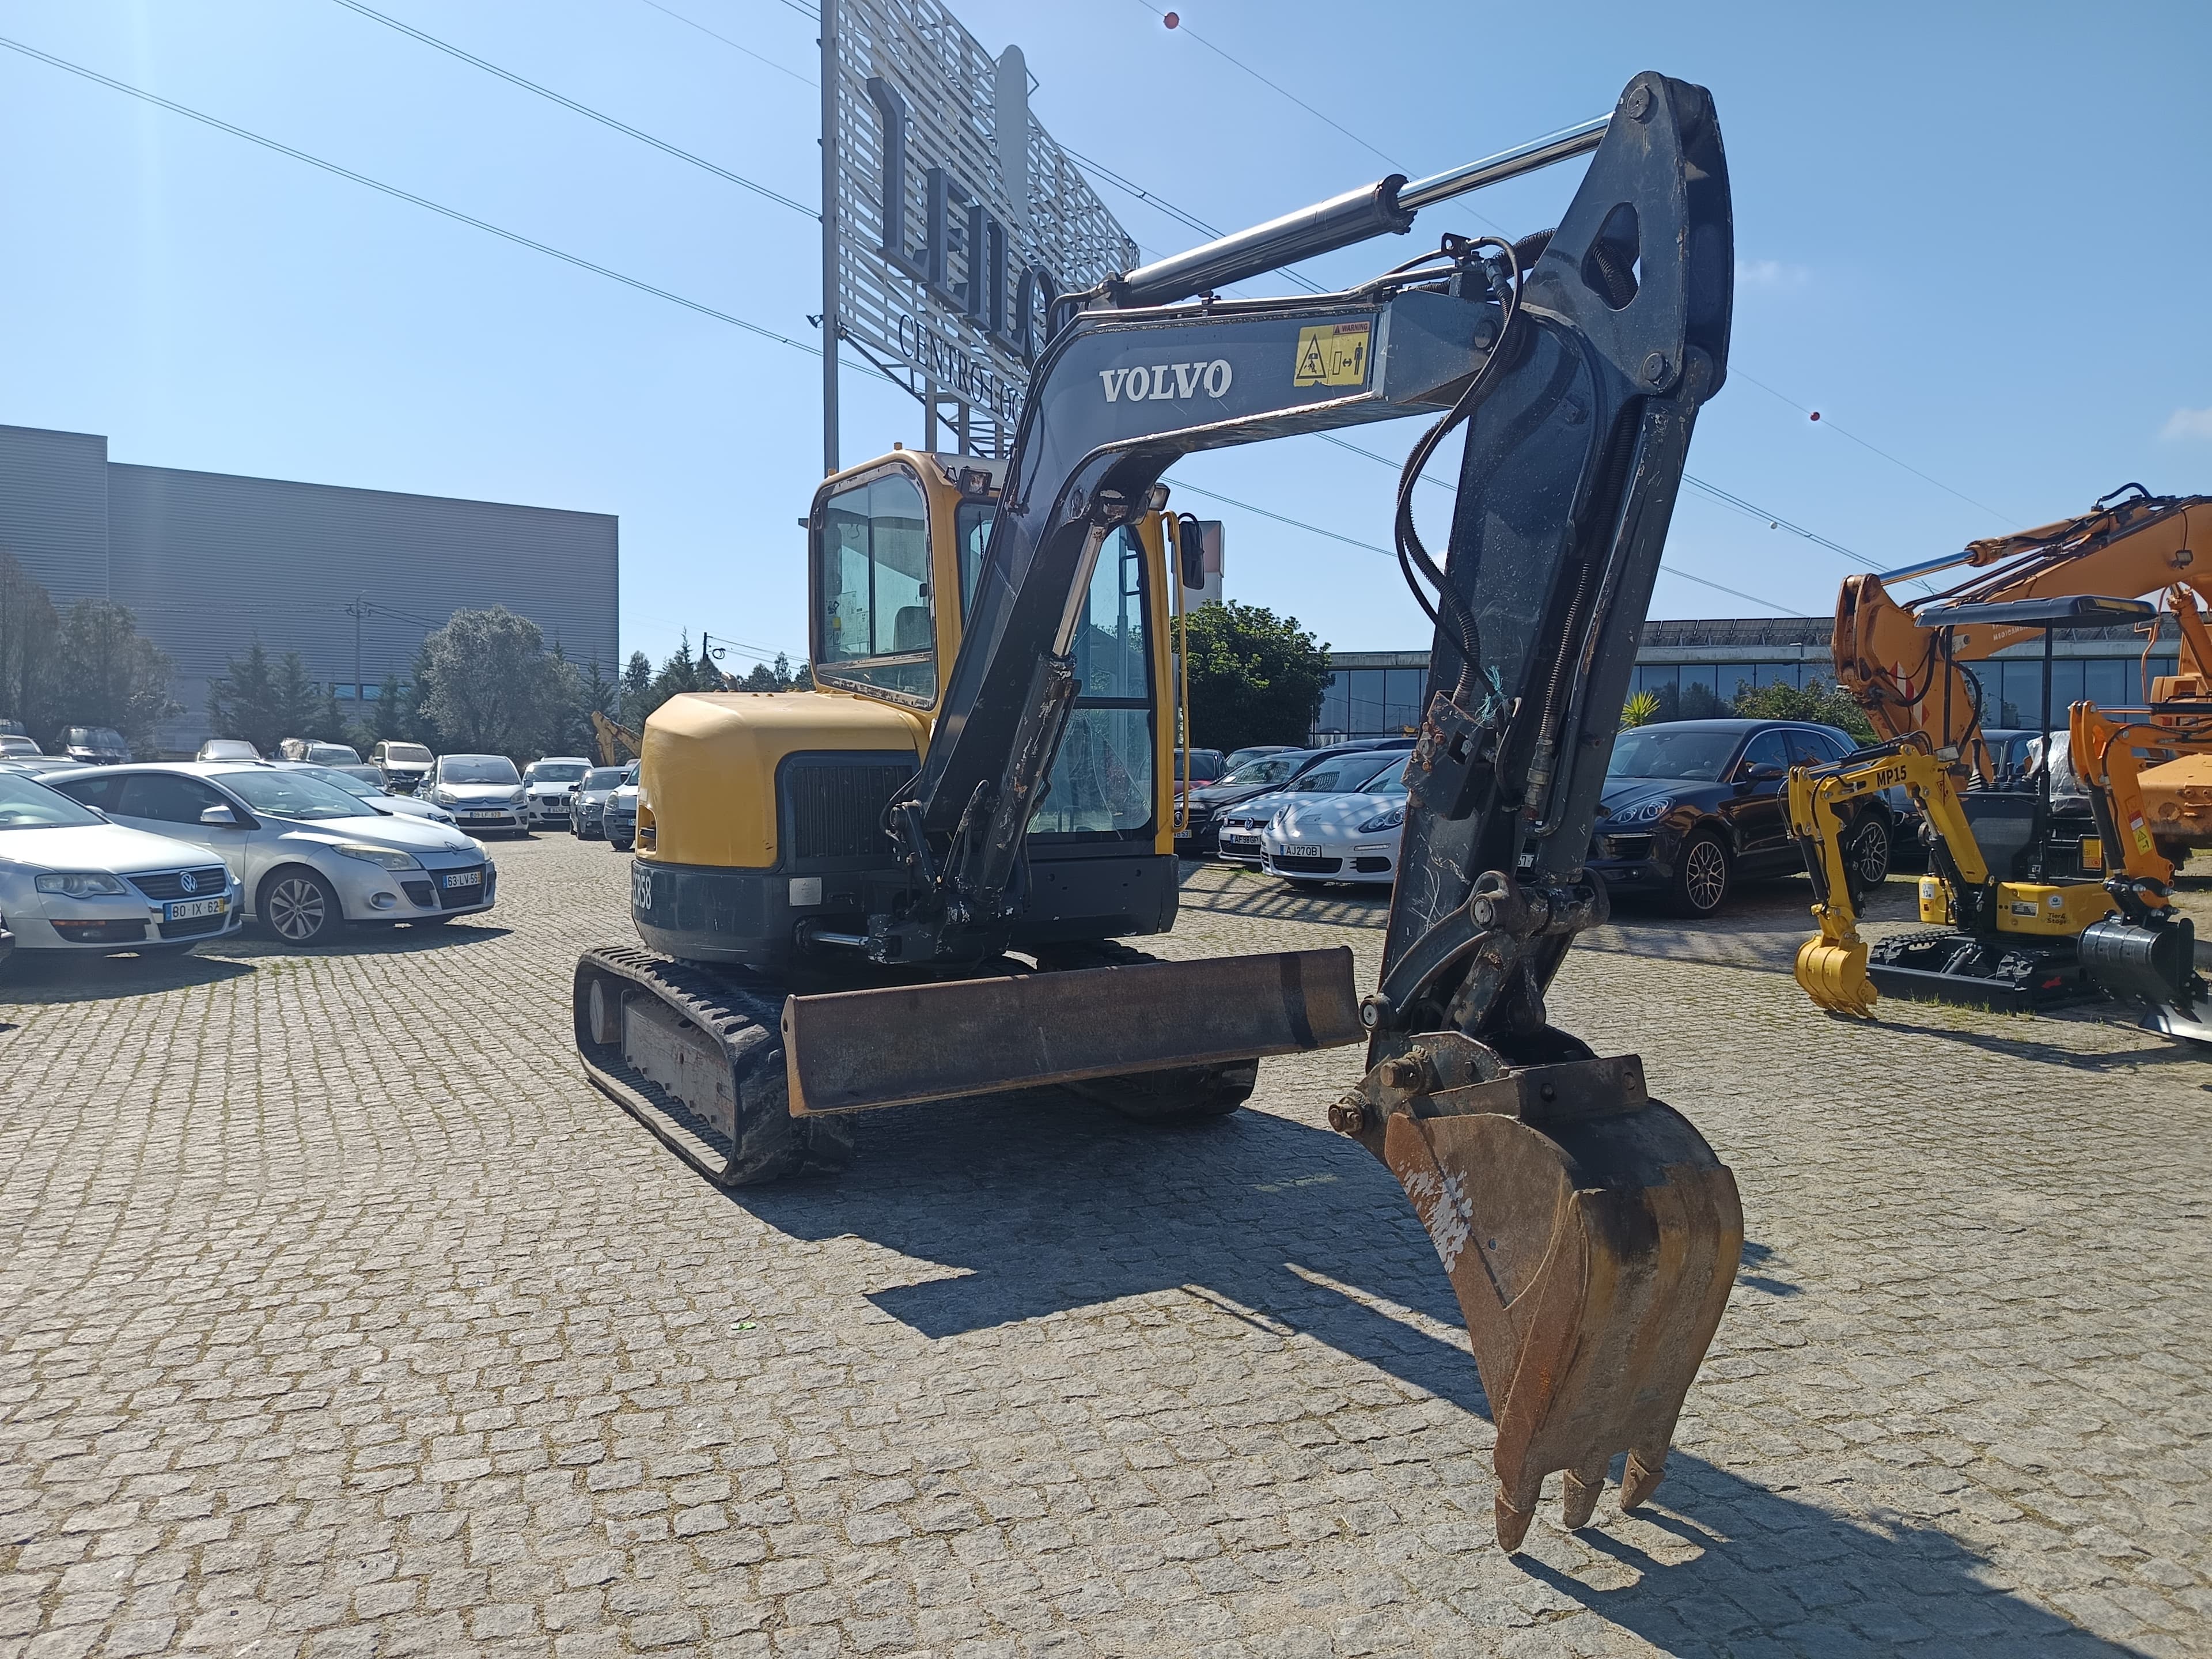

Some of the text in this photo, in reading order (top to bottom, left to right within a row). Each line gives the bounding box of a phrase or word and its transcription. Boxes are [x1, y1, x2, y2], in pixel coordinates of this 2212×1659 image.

[866, 77, 1078, 373] LEILO
[1342, 323, 1368, 332] WARNING
[899, 315, 983, 402] CENTRO
[1099, 359, 1232, 402] VOLVO
[1877, 765, 1907, 787] MP15
[1286, 846, 1317, 856] AJ27QB
